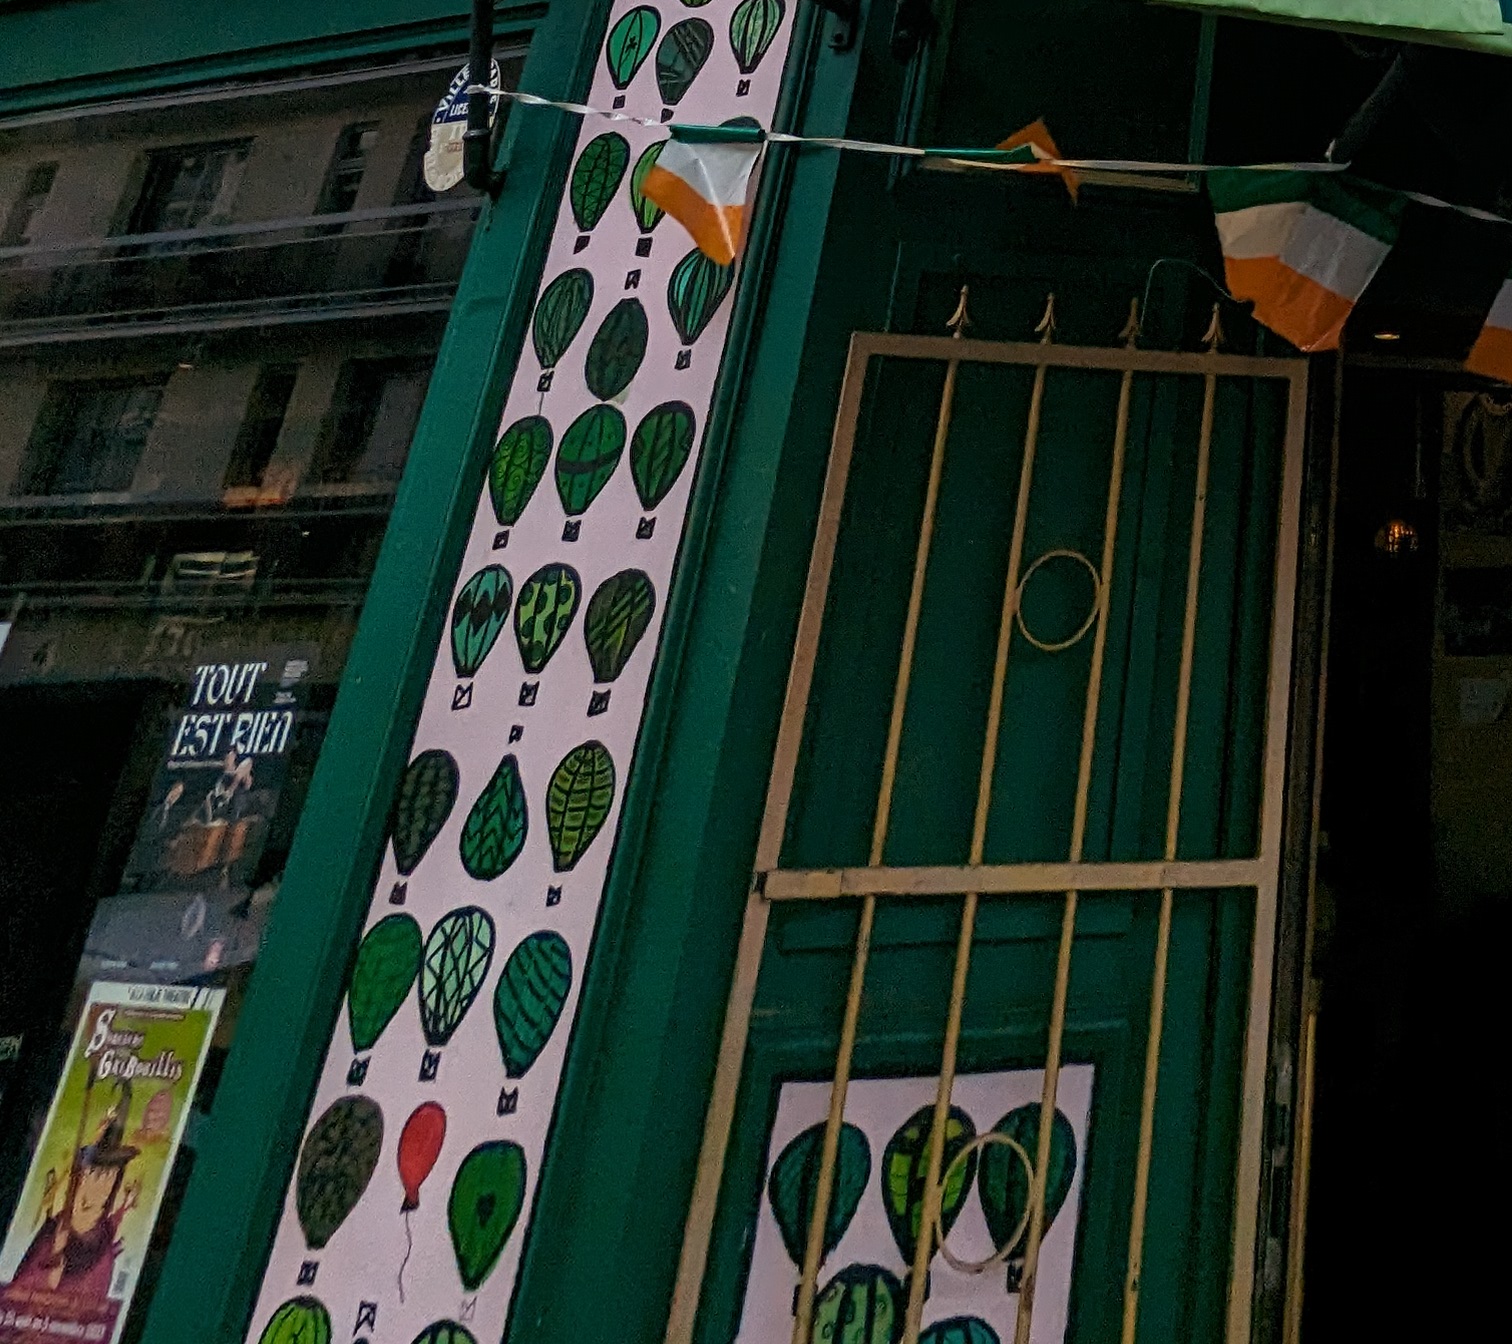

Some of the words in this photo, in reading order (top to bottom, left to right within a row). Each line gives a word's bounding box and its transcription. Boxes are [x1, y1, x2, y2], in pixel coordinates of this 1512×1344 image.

[192, 661, 269, 706] TOUT
[170, 712, 232, 756] EST
[230, 711, 294, 755] RIEN
